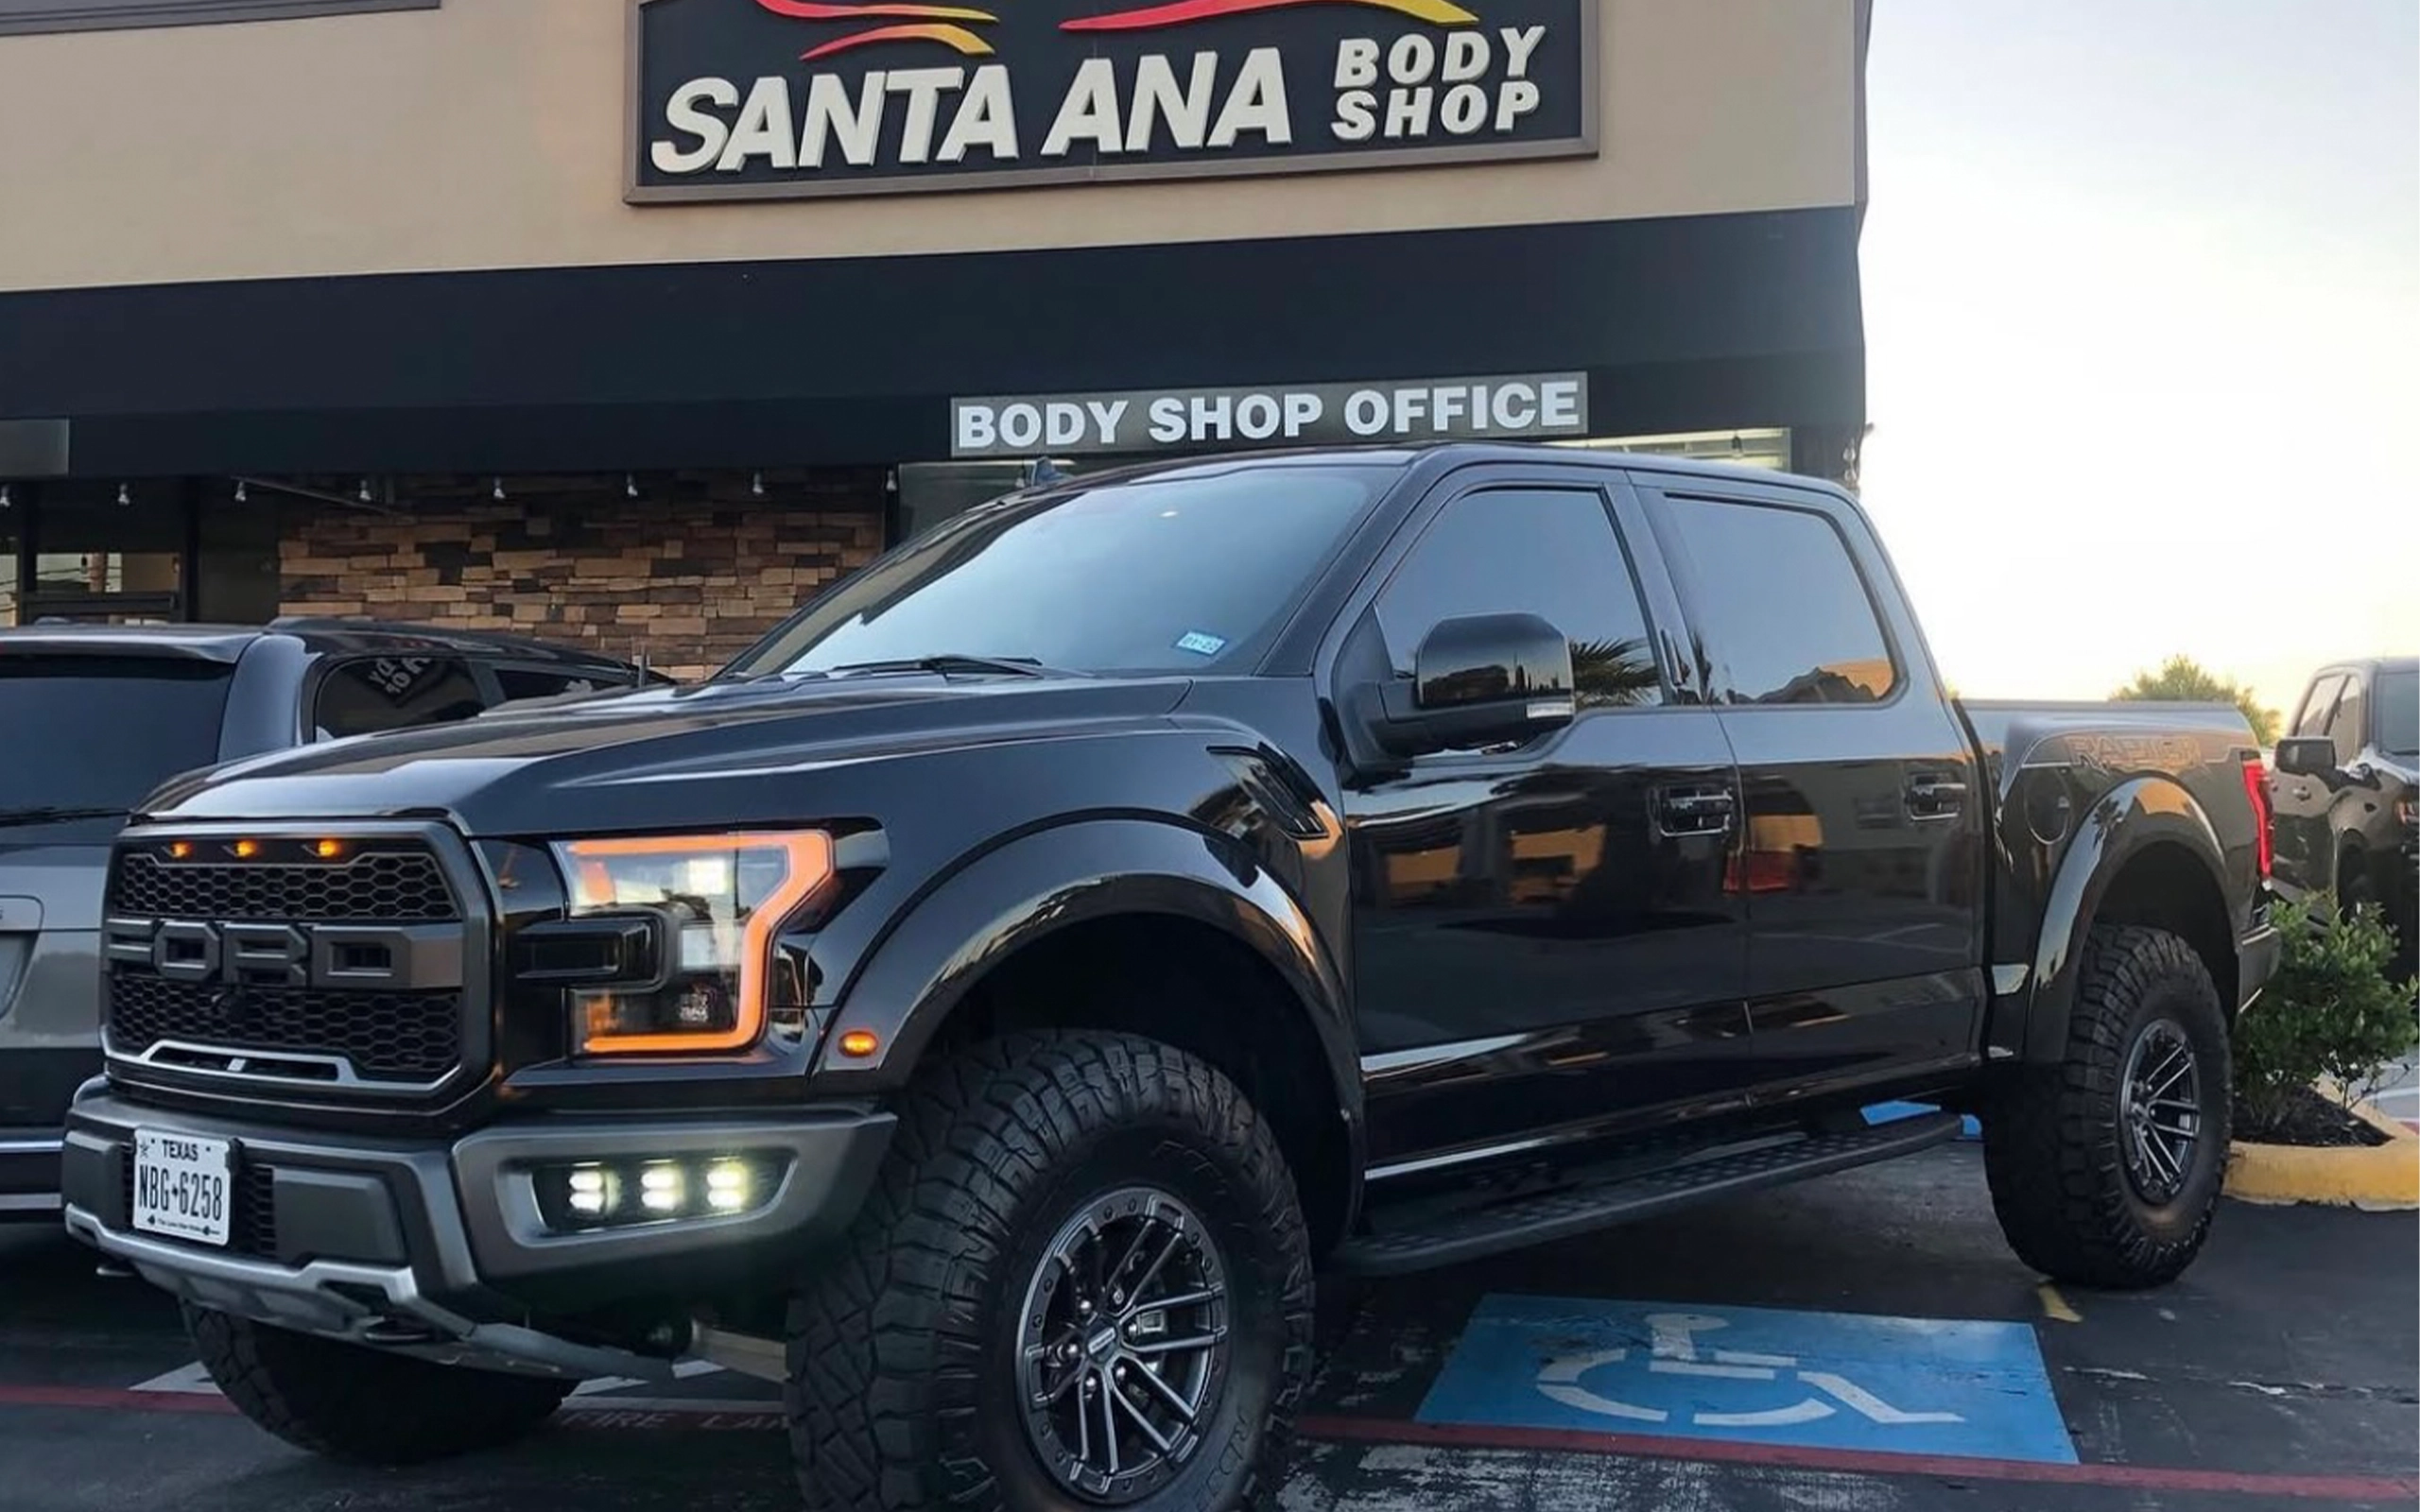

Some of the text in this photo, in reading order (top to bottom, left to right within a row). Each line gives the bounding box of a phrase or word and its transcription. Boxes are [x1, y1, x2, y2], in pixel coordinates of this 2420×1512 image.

[1334, 26, 1545, 89] BODY
[650, 46, 1293, 174] SANTA ANA
[1331, 81, 1541, 142] SHOP
[958, 381, 1581, 450] BODY SHOP OFFICE
[97, 918, 416, 989] FORD
[162, 1139, 199, 1161] TEXAS
